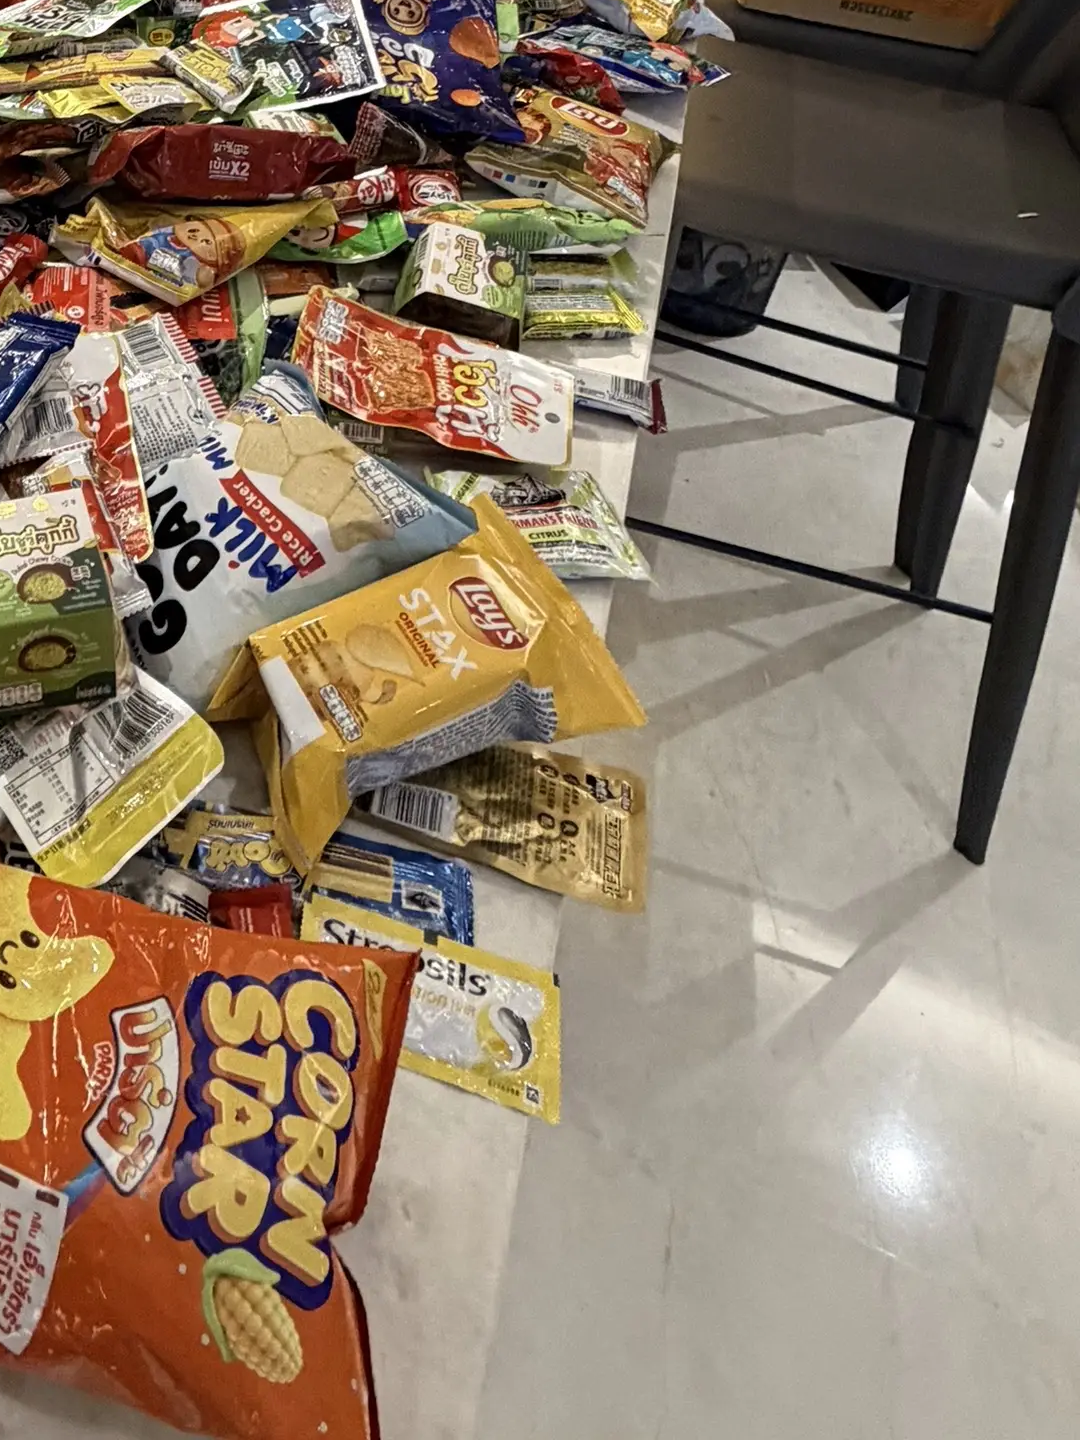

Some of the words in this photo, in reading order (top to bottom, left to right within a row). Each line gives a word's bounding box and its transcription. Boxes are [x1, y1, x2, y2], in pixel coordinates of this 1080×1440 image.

[233, 480, 282, 534] Cracker
[528, 528, 569, 540] CITRUS
[284, 533, 313, 568] Rice
[398, 611, 441, 669] ORIGINAL
[399, 587, 477, 680] STAX
[88, 1041, 115, 1101] PARTY
[186, 982, 286, 1240] STAR
[268, 978, 356, 1286] CORN
